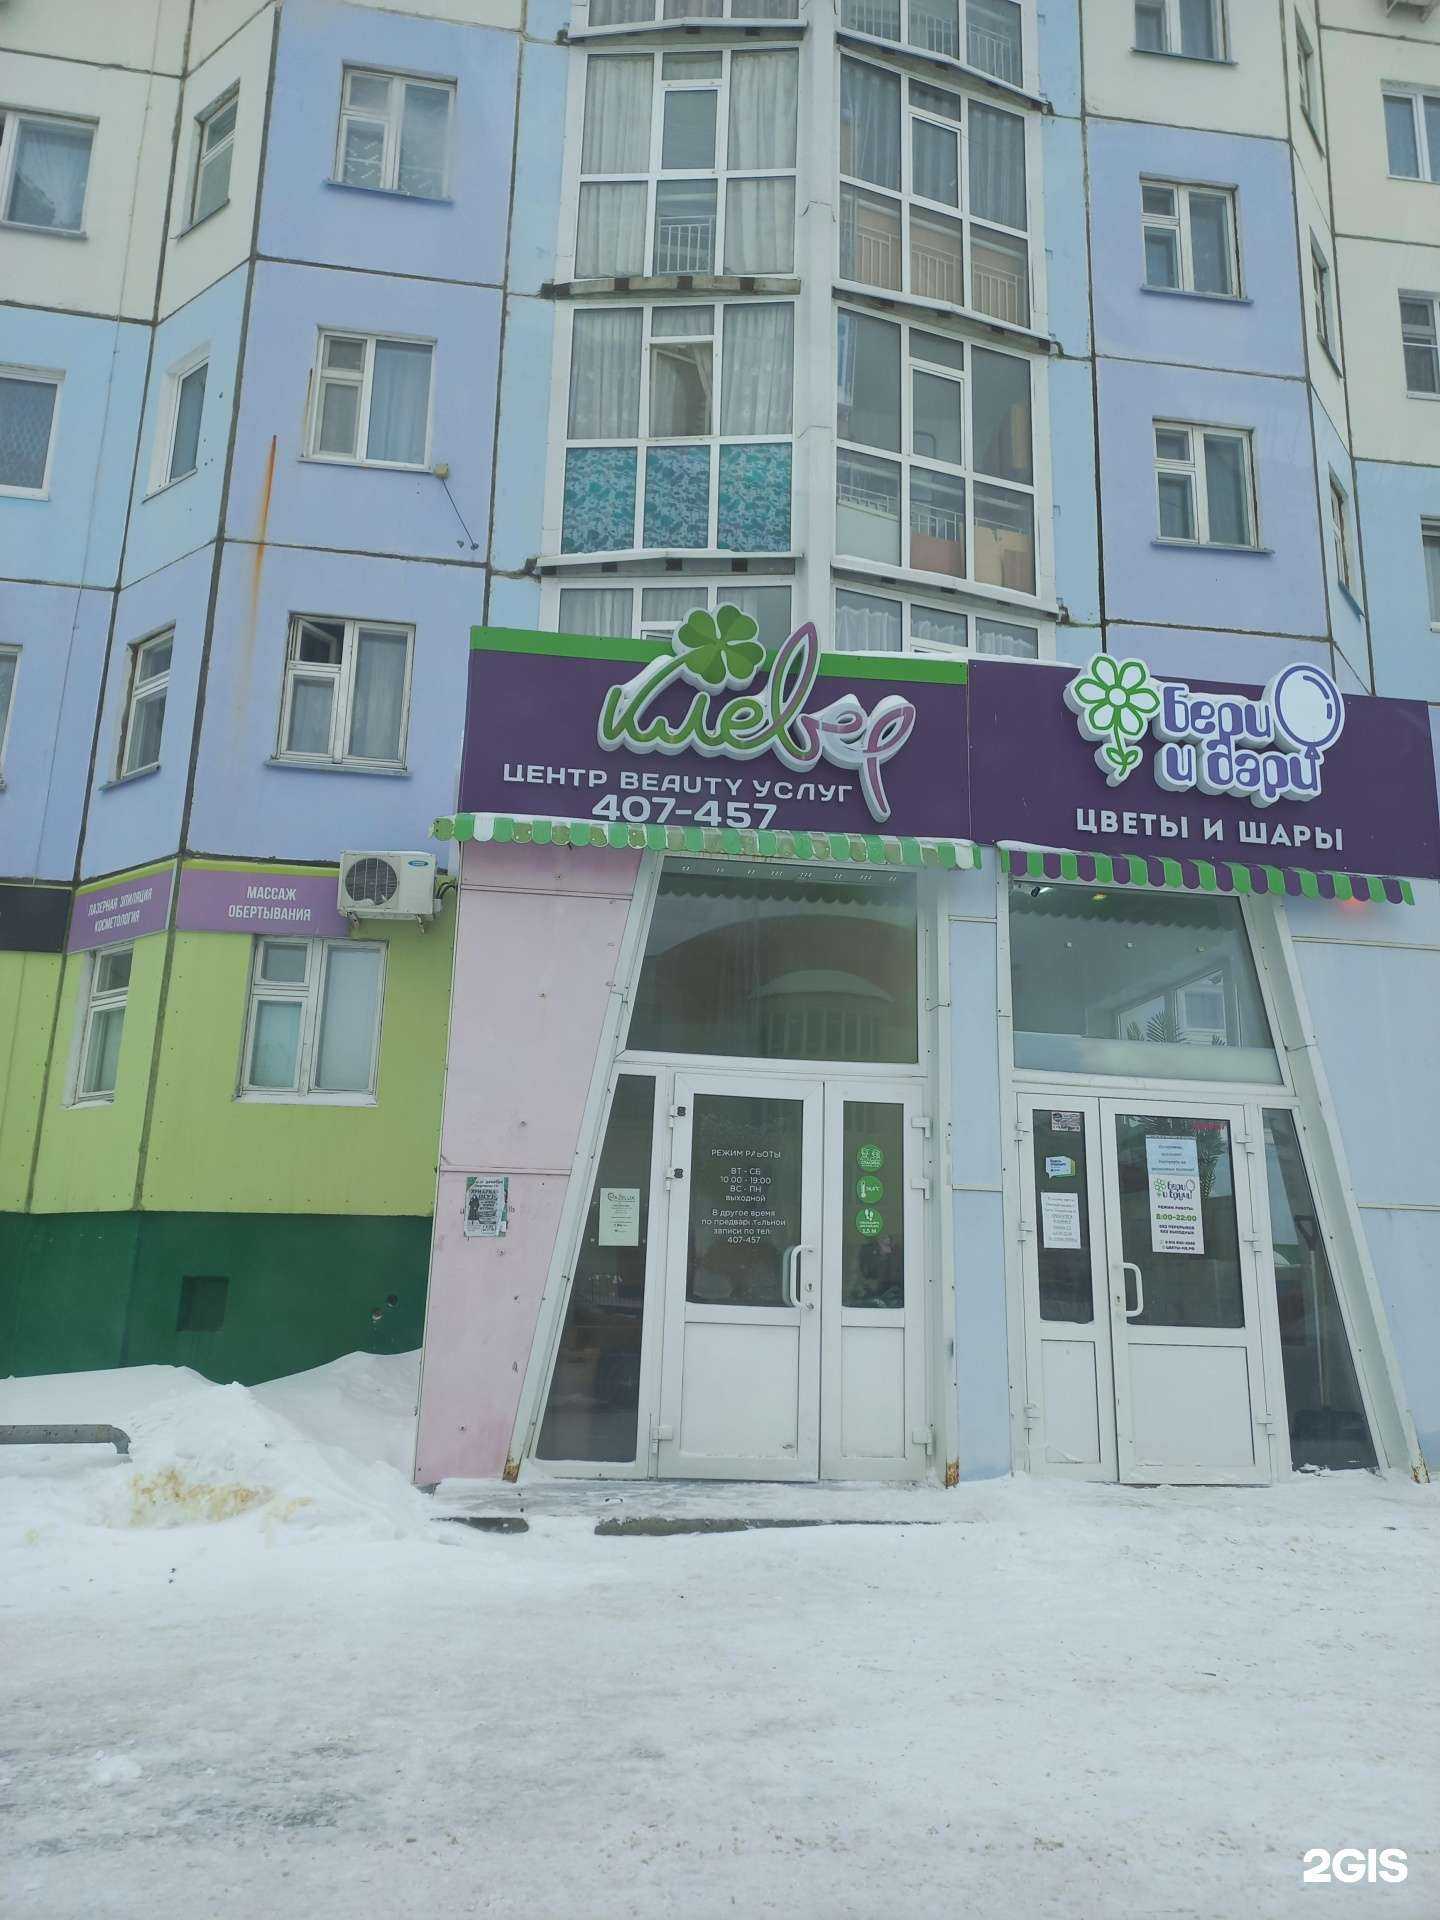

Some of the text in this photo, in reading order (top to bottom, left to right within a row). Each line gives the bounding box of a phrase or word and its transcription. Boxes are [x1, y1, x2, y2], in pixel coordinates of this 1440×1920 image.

[503, 763, 852, 802] ЦЕНТР BEAUTY УСЛУГ
[592, 795, 777, 829] 407-457
[1076, 808, 1344, 851] ЦВЕТЫ И ШАРЫ
[247, 886, 297, 901] МАССАЖ
[88, 888, 153, 917] ЛАЗЕРНАЯ ЭПИЛЯЦИЯ
[228, 904, 312, 921] ОБЕРТЫВАНИЯ
[94, 910, 140, 933] КОСМЕТОЛОГИЯ
[711, 1149, 744, 1157] РЕЖИМ
[749, 1167, 761, 1175] СБ
[749, 1185, 762, 1193] ПН
[720, 1210, 749, 1218] другое
[727, 1236, 761, 1244] 407-457
